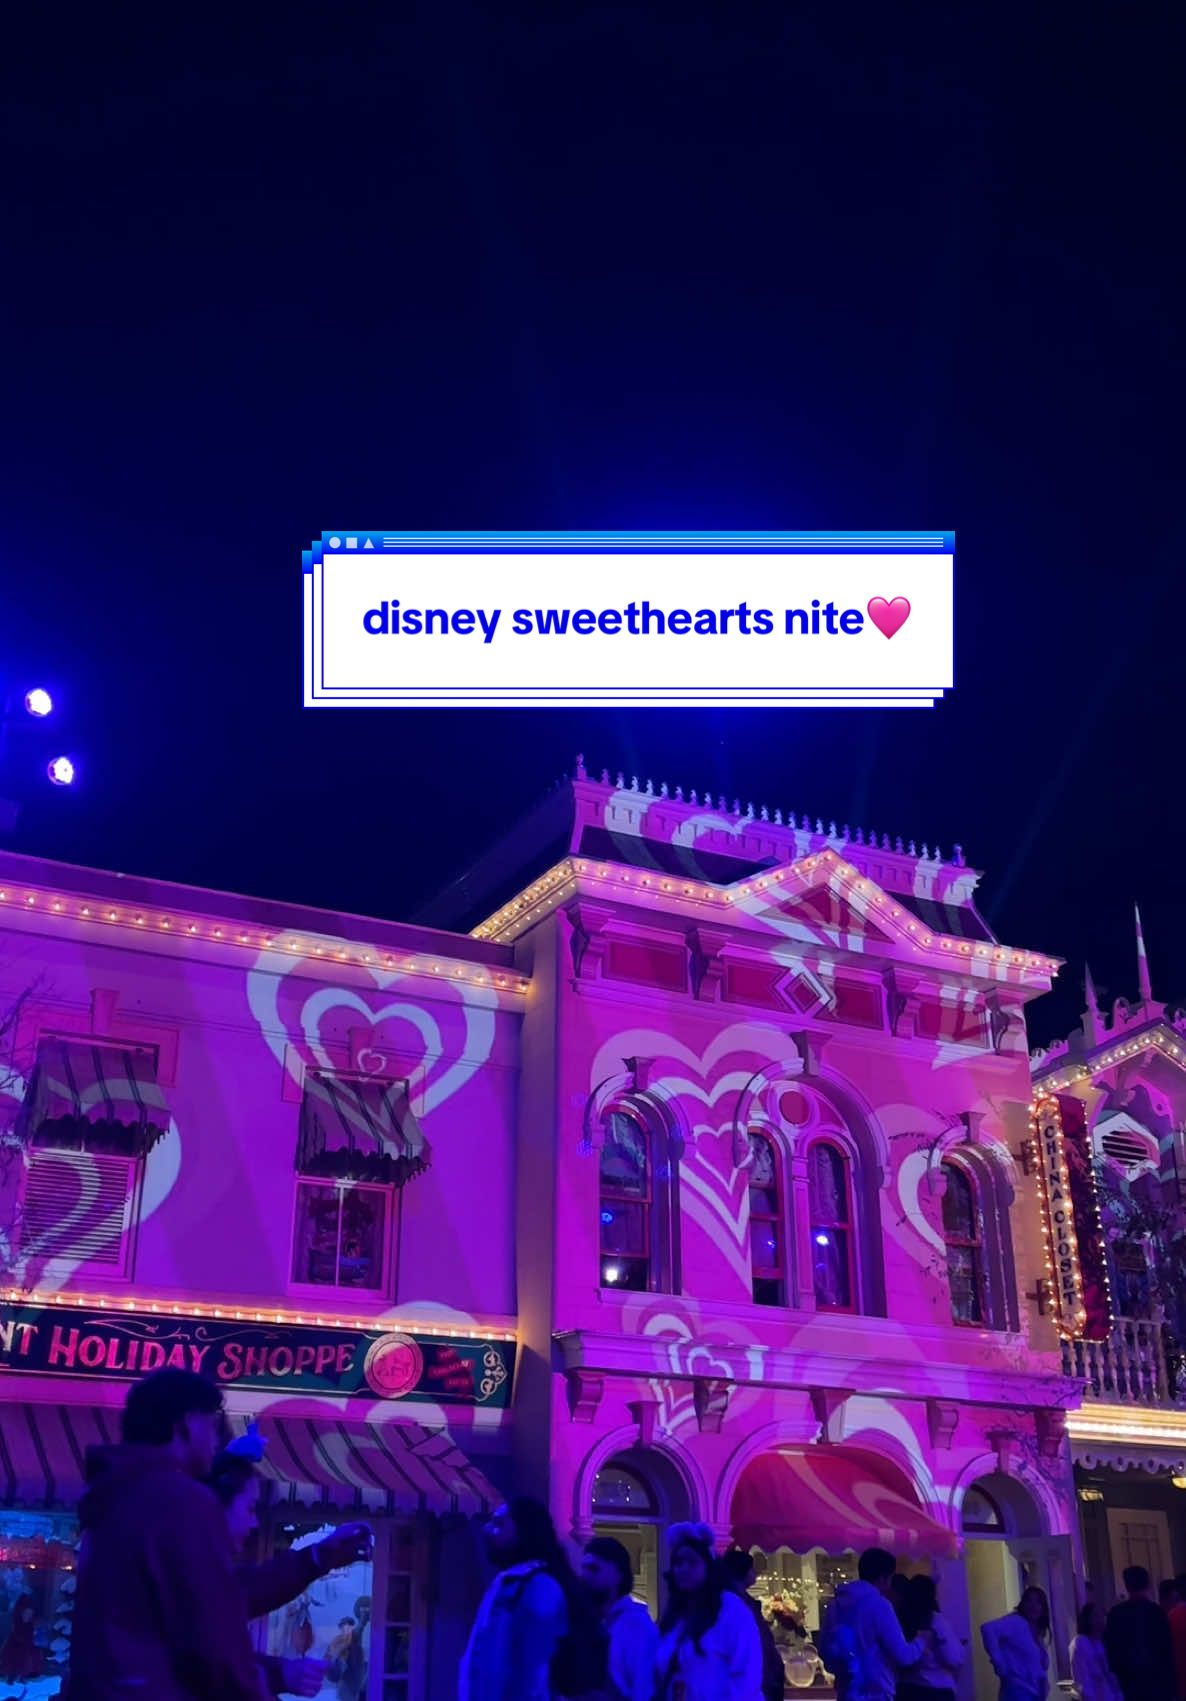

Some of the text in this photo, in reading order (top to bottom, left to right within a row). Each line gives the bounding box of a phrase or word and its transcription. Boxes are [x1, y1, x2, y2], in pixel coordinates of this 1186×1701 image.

[1044, 1125, 1076, 1305] CHINA CLOSET
[48, 1325, 211, 1373] HOLIDAY
[217, 1342, 356, 1379] SHOPPE
